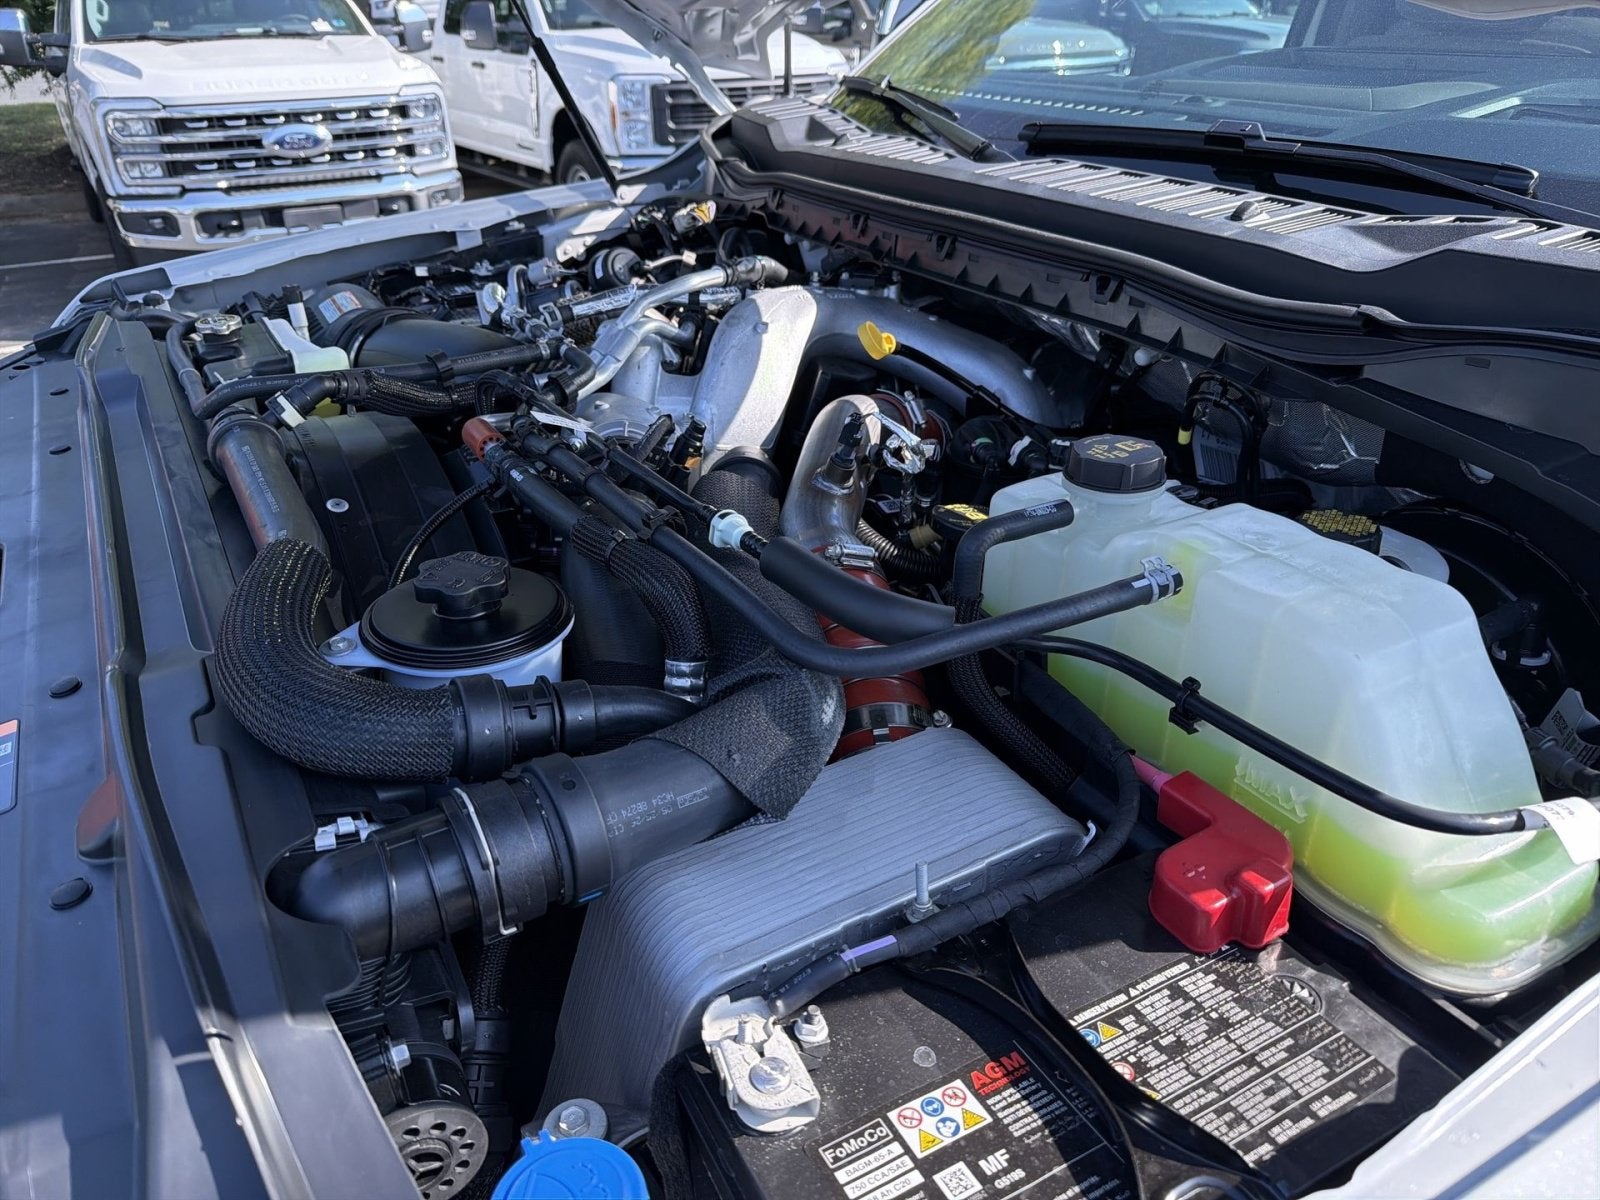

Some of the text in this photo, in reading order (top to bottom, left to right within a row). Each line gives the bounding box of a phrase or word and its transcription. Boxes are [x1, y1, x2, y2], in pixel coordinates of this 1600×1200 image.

[970, 1051, 1026, 1090] AGM
[978, 1066, 1030, 1096] TECHNOLOGY
[986, 1077, 1035, 1105] NON-SPILLABLE
[991, 1082, 1042, 1111] Lead Acid Battery
[824, 1126, 887, 1162] FoMoCo
[844, 1148, 895, 1177] BAGM-65-A
[978, 1148, 1010, 1176] MF
[850, 1159, 909, 1195] 750 CCA/SAE
[880, 1188, 893, 1200] Ah
[894, 1177, 911, 1192] C20
[994, 1168, 1026, 1189] G519S
